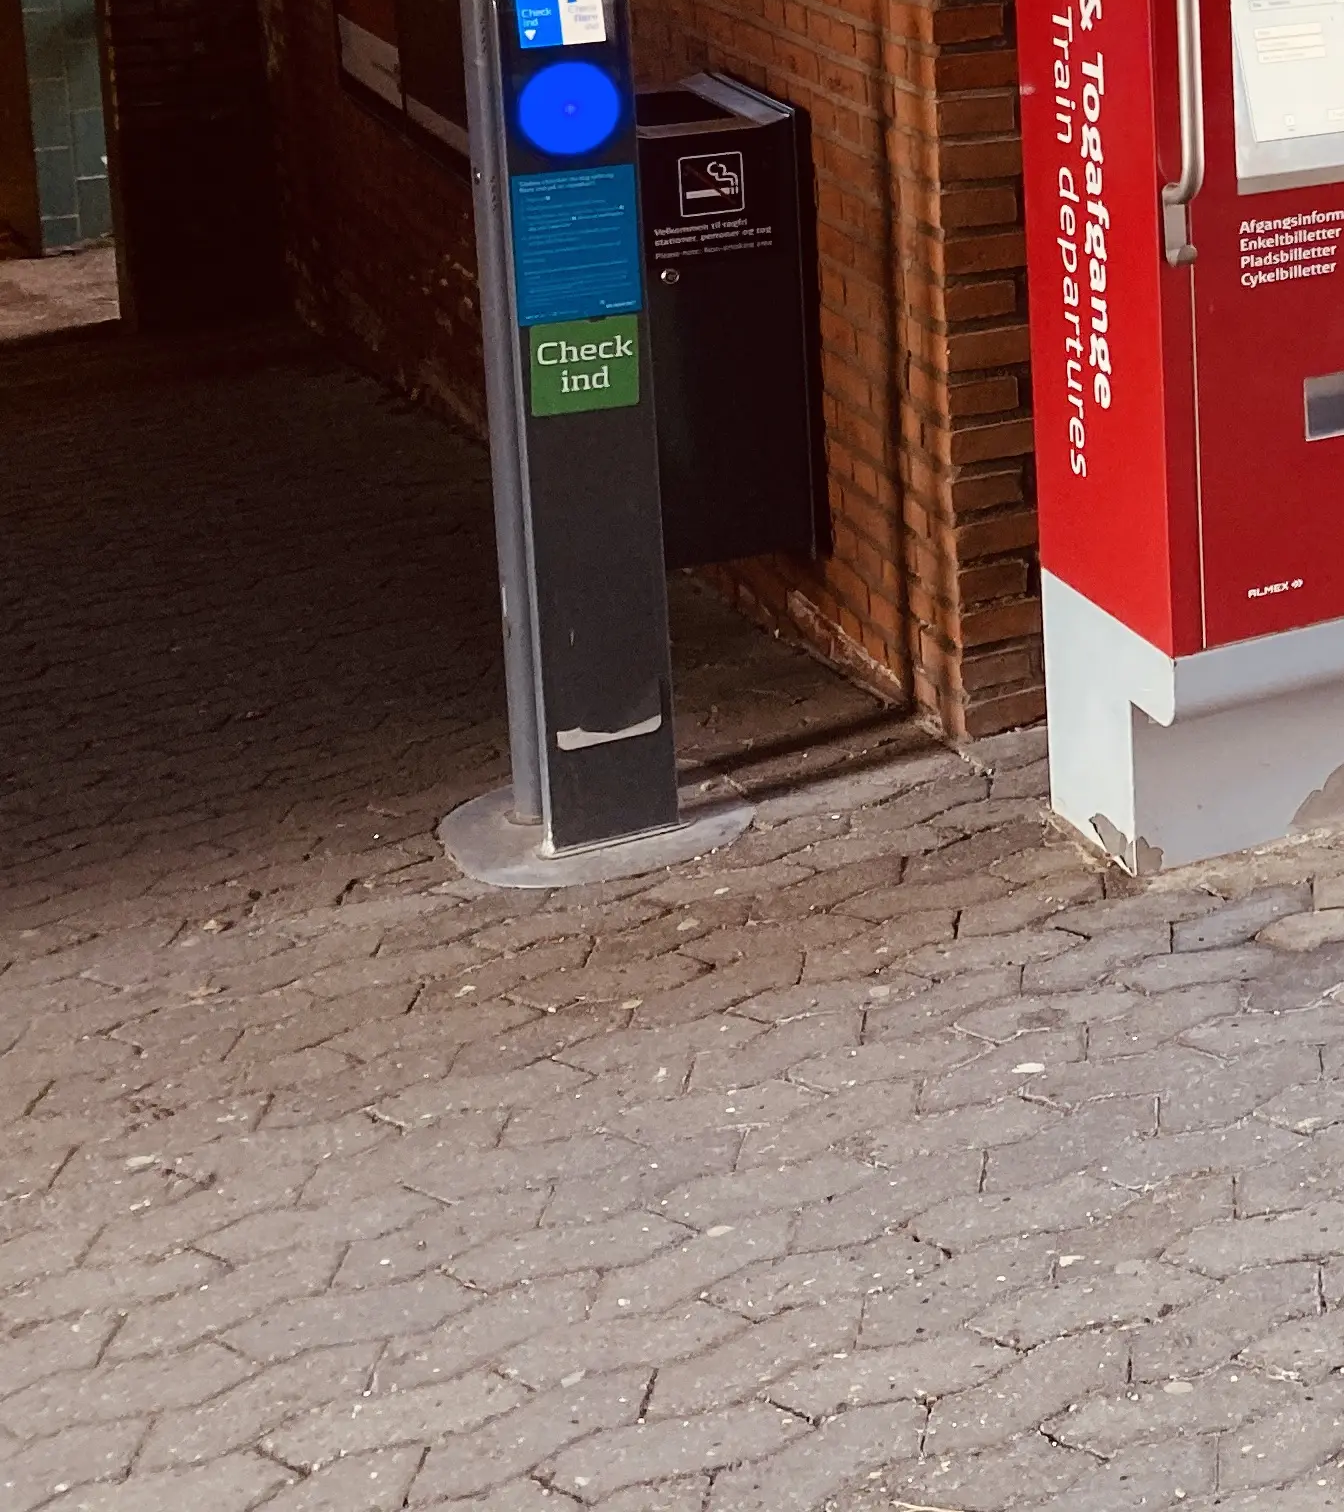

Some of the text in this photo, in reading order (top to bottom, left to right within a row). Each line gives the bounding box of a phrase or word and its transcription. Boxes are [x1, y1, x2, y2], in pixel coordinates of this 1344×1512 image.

[521, 7, 552, 19] Check
[522, 17, 539, 28] ind
[1051, 6, 1077, 144] Train
[1081, 51, 1111, 410] Togafgange
[1239, 228, 1342, 252] Enkeltbilletter
[1240, 245, 1337, 268] Pladsbilletter
[1240, 262, 1337, 288] Cykelbilletter
[1056, 165, 1088, 479] departures
[537, 334, 632, 365] Check
[561, 365, 610, 393] ind
[1247, 580, 1289, 599] ALMEX
